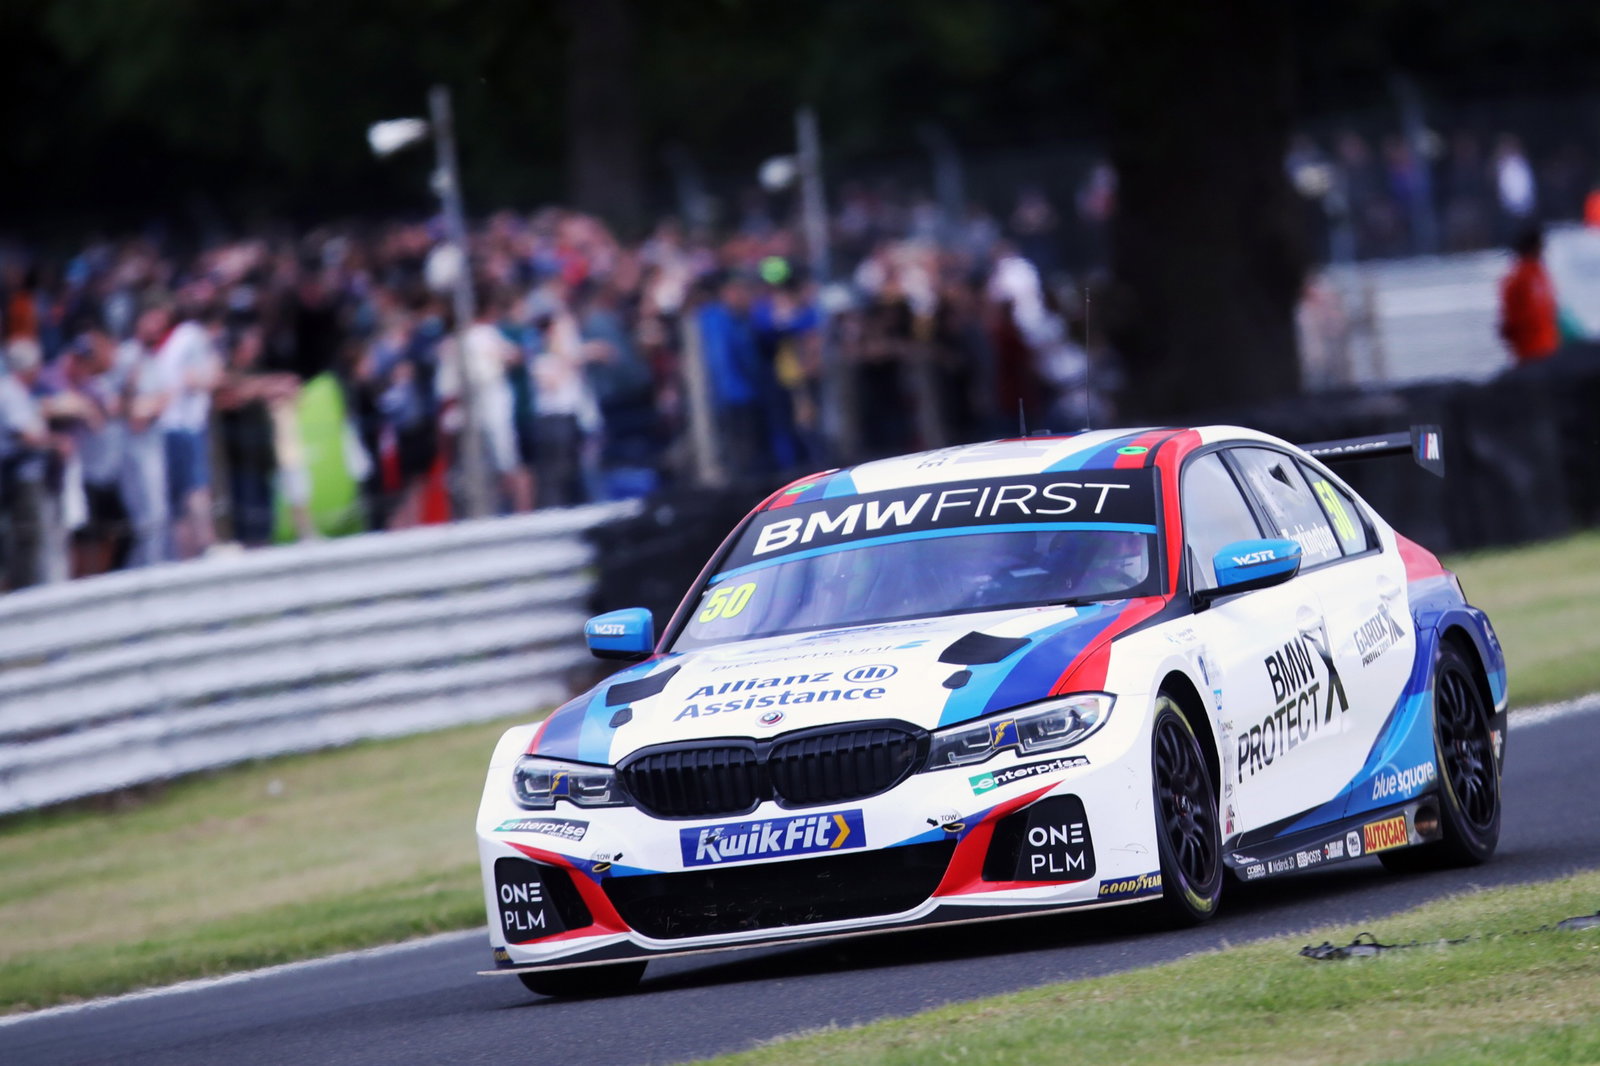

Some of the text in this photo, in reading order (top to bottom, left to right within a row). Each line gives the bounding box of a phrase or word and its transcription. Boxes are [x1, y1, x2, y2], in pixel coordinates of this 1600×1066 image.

[1232, 550, 1276, 566] WSR
[699, 582, 756, 623] 50
[1264, 636, 1315, 705] BMW
[684, 672, 833, 701] Allianz
[672, 686, 886, 722] Assistance
[1237, 681, 1320, 784] PROTECT
[972, 758, 1088, 789] enterprise
[1372, 760, 1434, 801] blue square
[501, 821, 585, 836] enterprise
[1028, 822, 1084, 848] ONE
[1365, 819, 1407, 852] AUTOCAR
[1031, 851, 1085, 874] PLM
[501, 882, 542, 904] ONE
[505, 909, 545, 931] PLM
